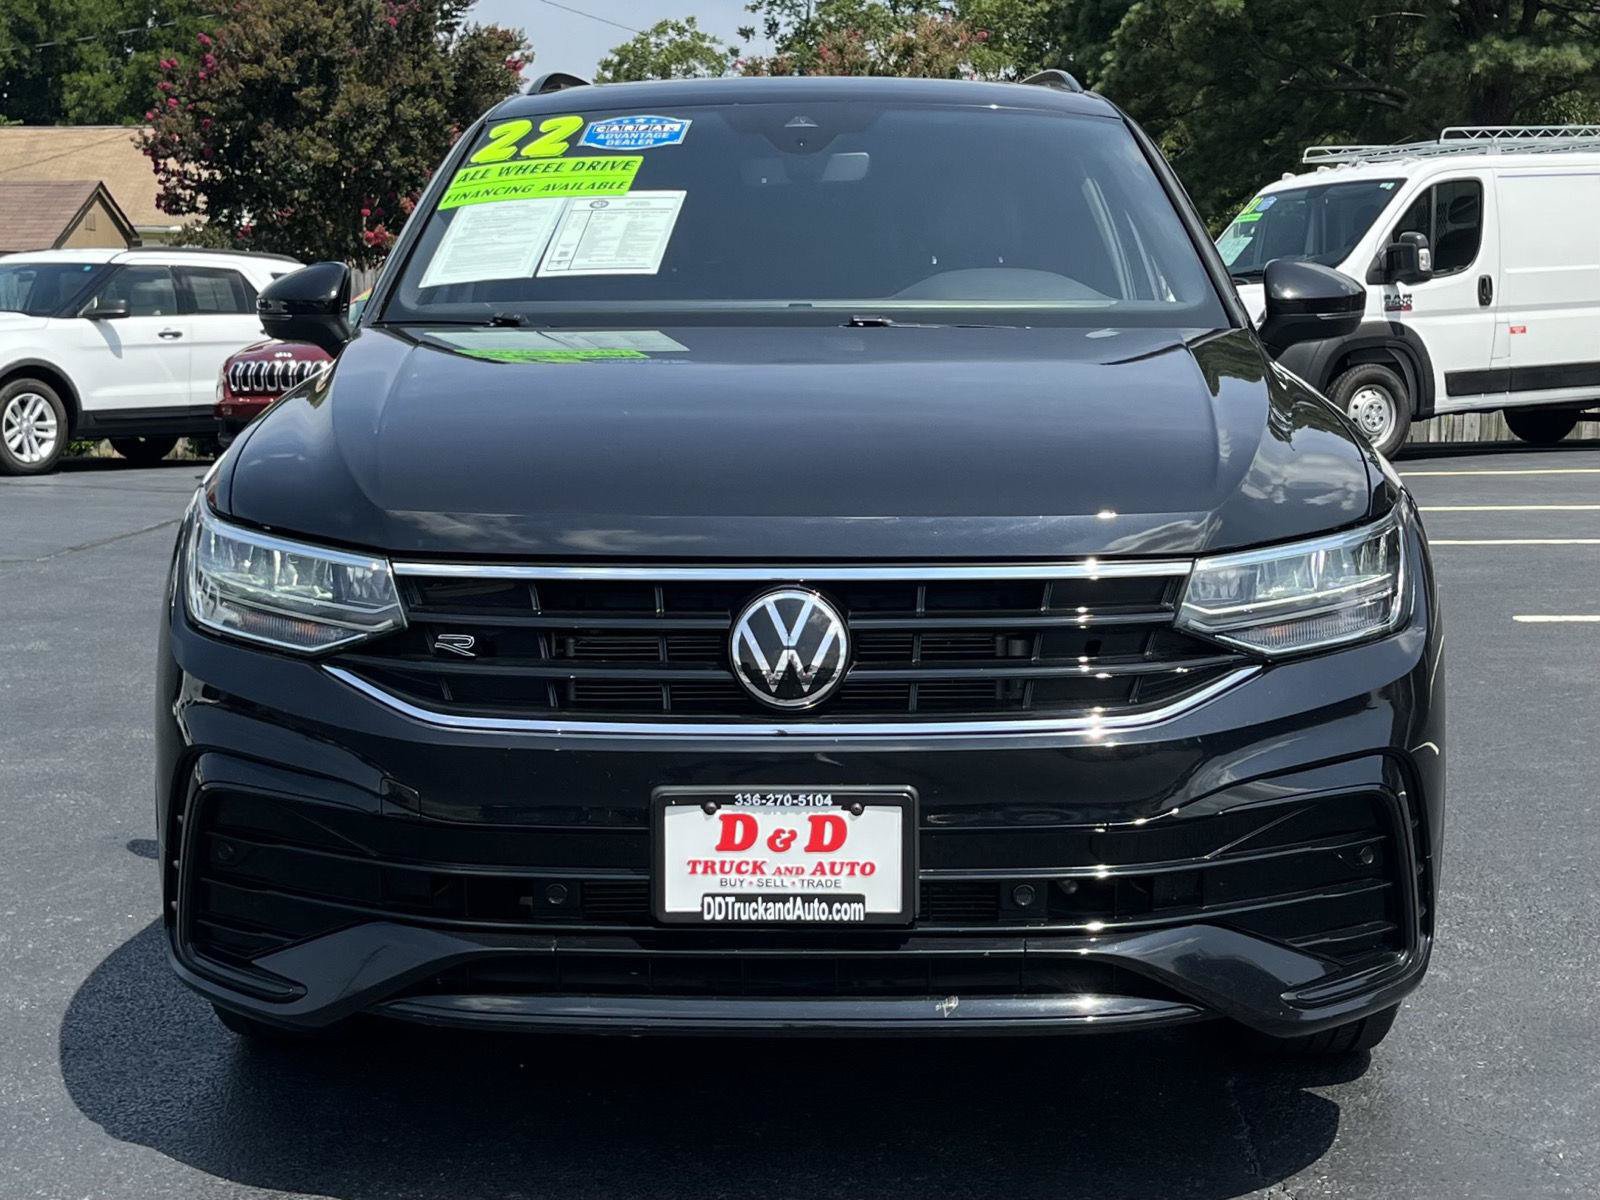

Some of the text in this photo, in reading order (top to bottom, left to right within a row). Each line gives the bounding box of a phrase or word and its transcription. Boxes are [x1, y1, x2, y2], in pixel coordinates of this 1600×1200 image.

[470, 115, 585, 164] 22
[597, 132, 670, 140] ADVANTAGE
[605, 138, 655, 146] DEALER
[455, 160, 638, 184] ALL WHEEL DRIVE
[443, 181, 629, 204] FINANCING AVAILABLE
[734, 793, 833, 807] 336-270-5104
[715, 813, 848, 853] D & D
[687, 860, 876, 876] TRUCK AND AUTO
[719, 877, 842, 888] BUY SELL TRADE
[703, 896, 866, 922] DDTruckandAuto.com
